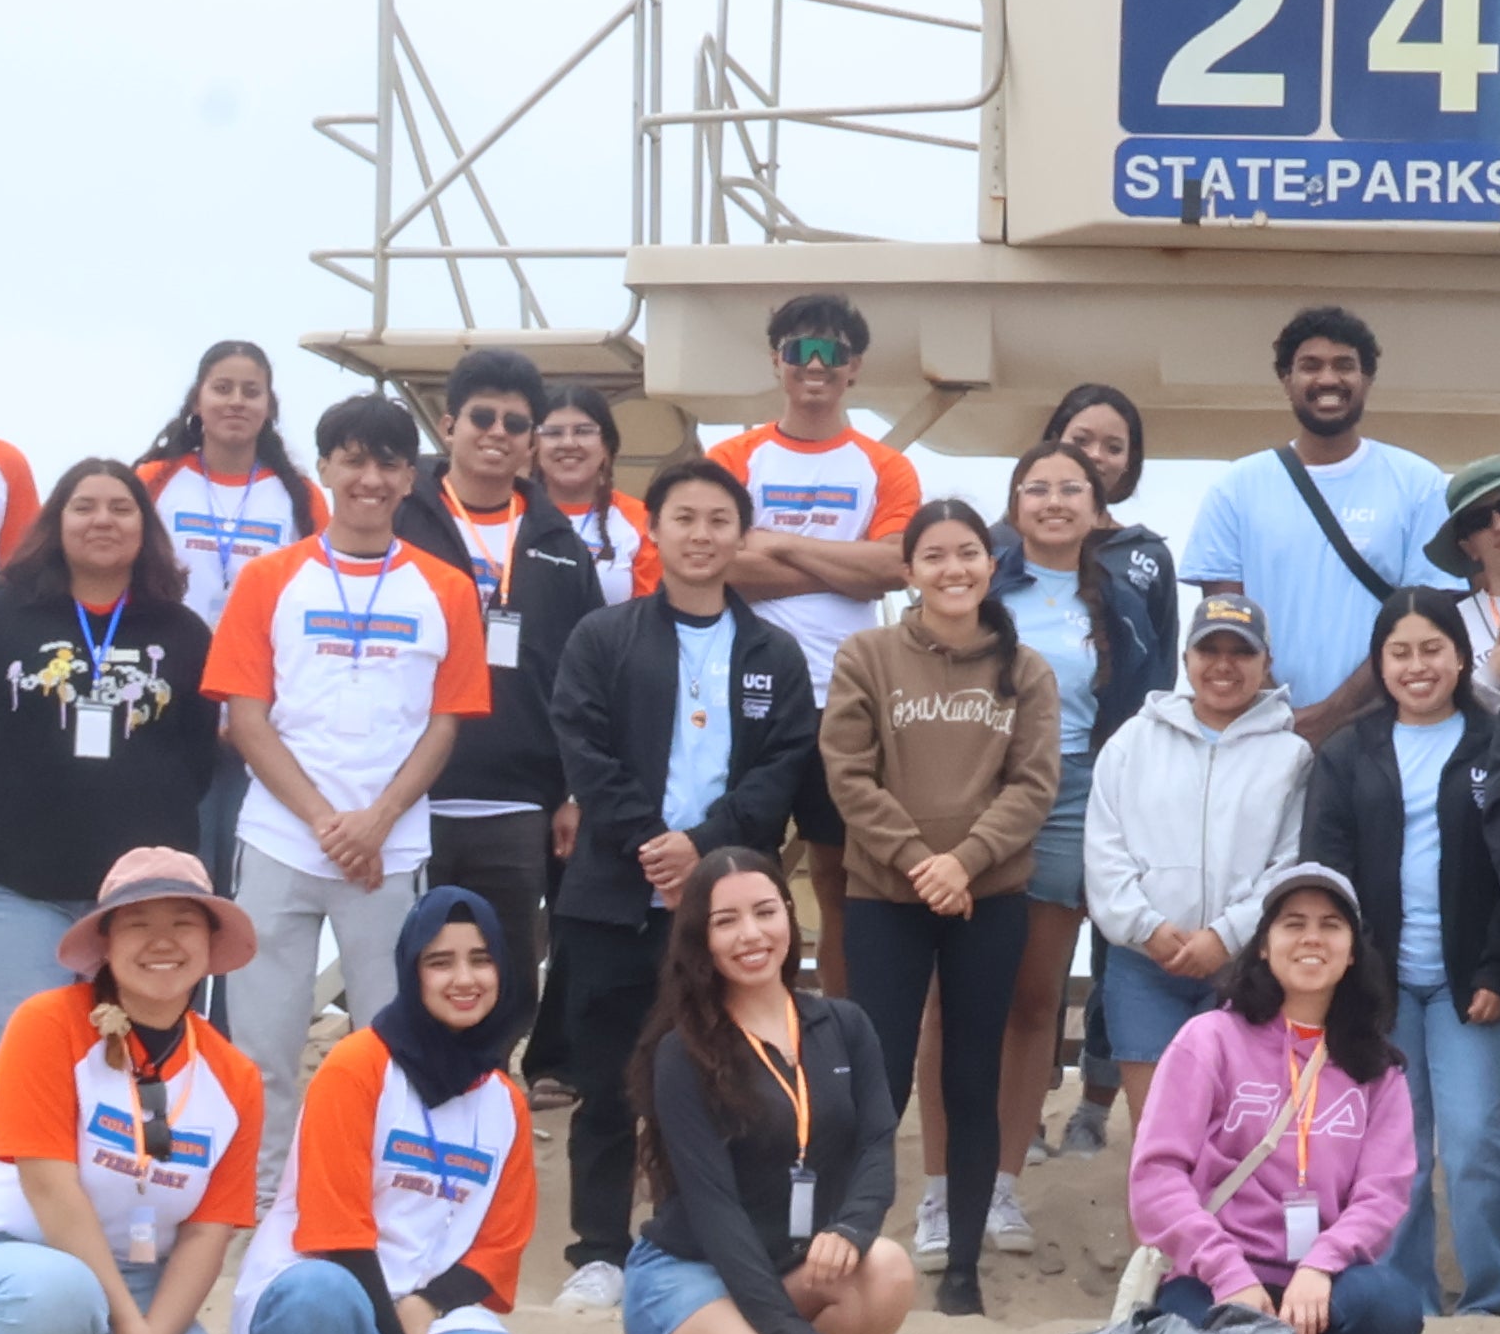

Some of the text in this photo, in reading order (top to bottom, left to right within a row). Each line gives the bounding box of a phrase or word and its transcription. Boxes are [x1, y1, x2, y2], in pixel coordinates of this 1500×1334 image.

[1124, 154, 1308, 202] STATE
[1341, 506, 1376, 524] UCI
[1130, 549, 1160, 578] UCI
[742, 672, 774, 691] UCI
